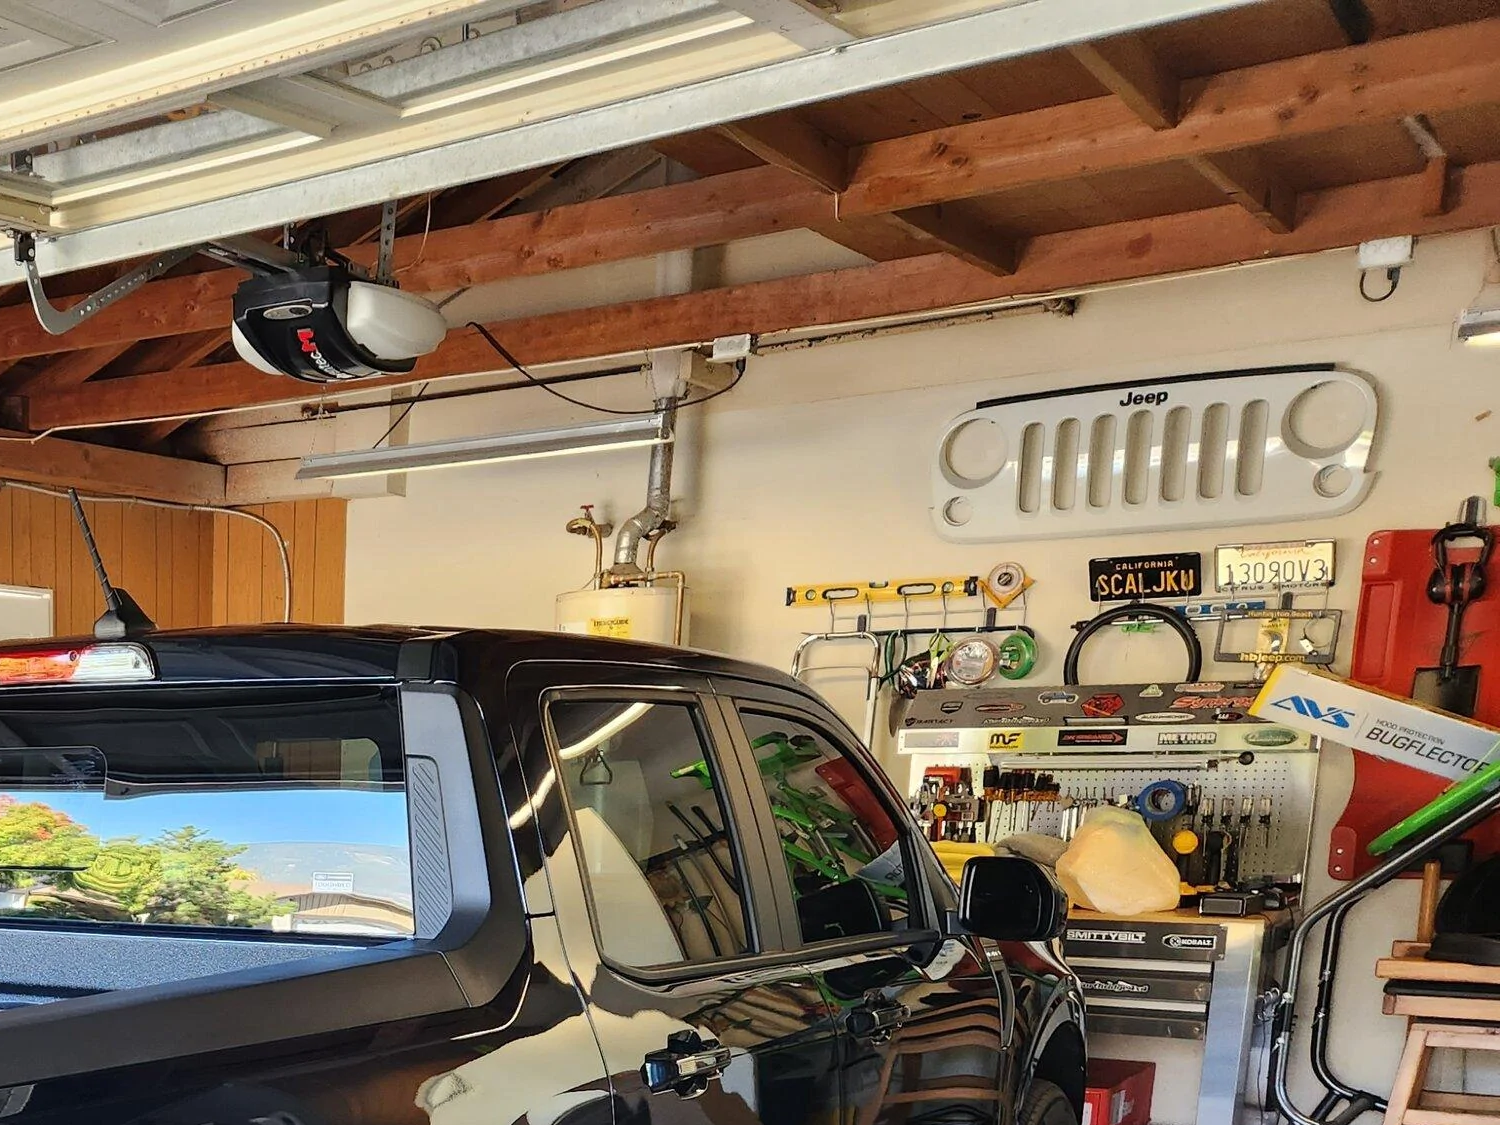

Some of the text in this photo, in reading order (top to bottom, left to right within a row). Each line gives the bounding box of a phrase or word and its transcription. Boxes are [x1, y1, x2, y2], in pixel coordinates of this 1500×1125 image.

[1119, 390, 1169, 407] Jeep
[1115, 560, 1174, 571] CALIFORNIA
[1223, 558, 1327, 586] 13090V3
[1375, 718, 1446, 746] HOOD PROTECTION
[1066, 928, 1147, 944] SMITTYBILT
[1181, 938, 1212, 947] KOBALT
